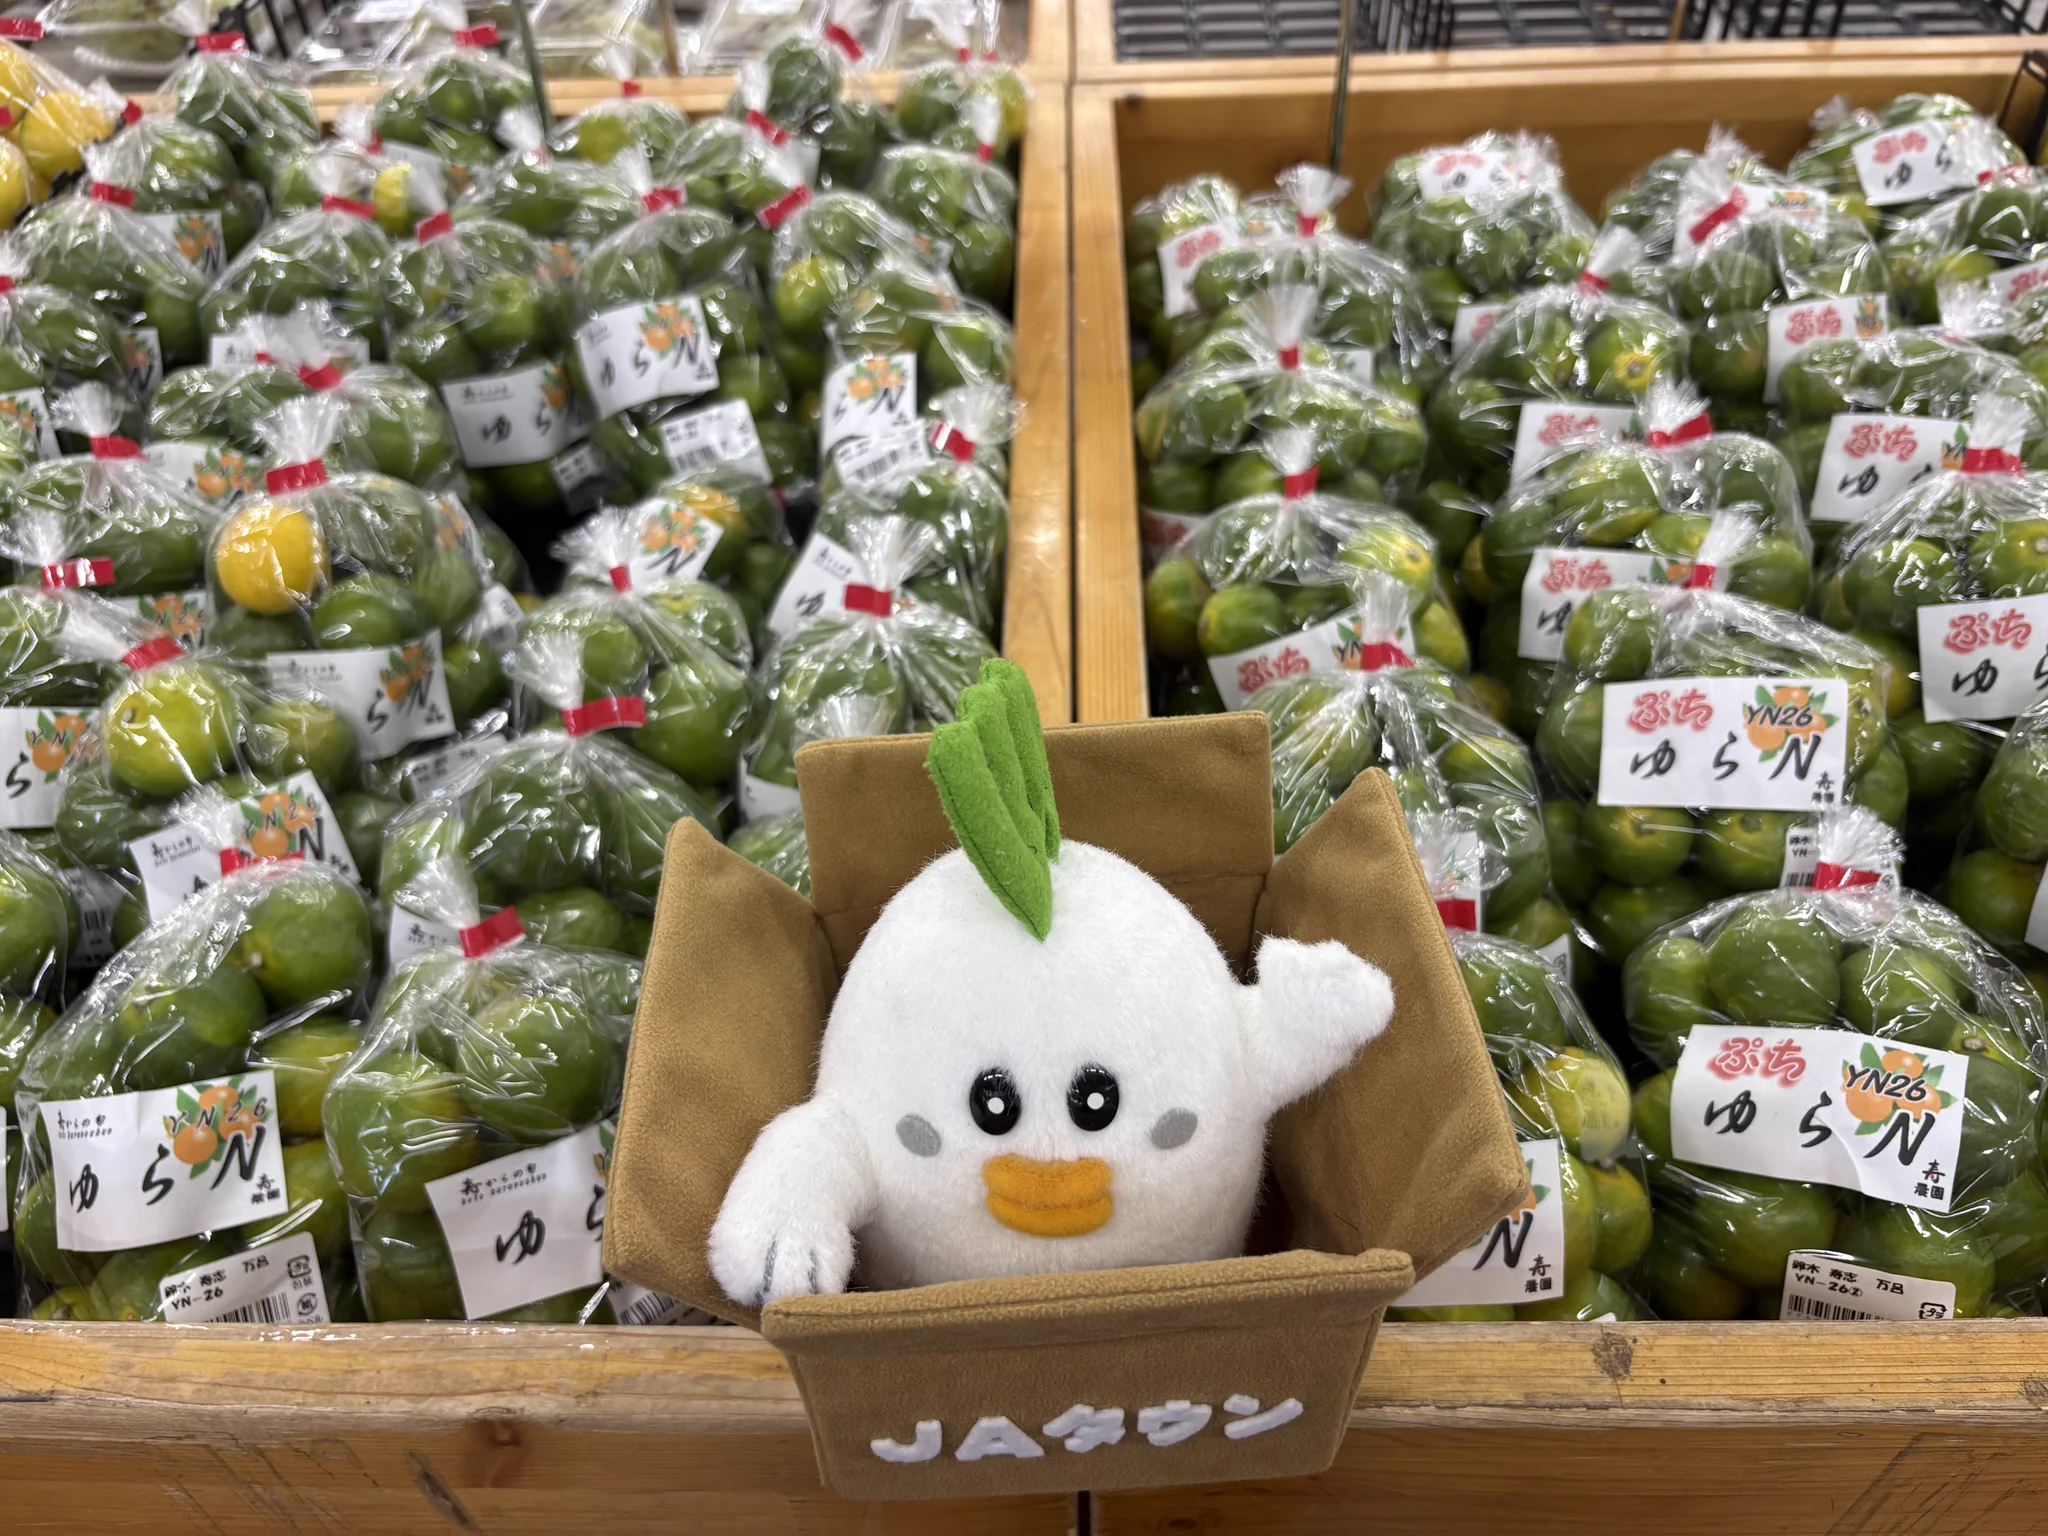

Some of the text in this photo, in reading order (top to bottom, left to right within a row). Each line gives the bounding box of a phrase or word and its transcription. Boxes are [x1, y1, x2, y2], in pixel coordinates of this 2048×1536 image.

[1844, 421, 1918, 462] ぷち
[1943, 608, 2032, 655] ぷち
[1626, 688, 1714, 733] ぷち
[1747, 705, 1814, 727] YN26
[1708, 1036, 1806, 1088] ぷち
[1845, 1065, 1926, 1101] YN26
[170, 1097, 267, 1133] YN26
[871, 1394, 1304, 1463] JAタウン
